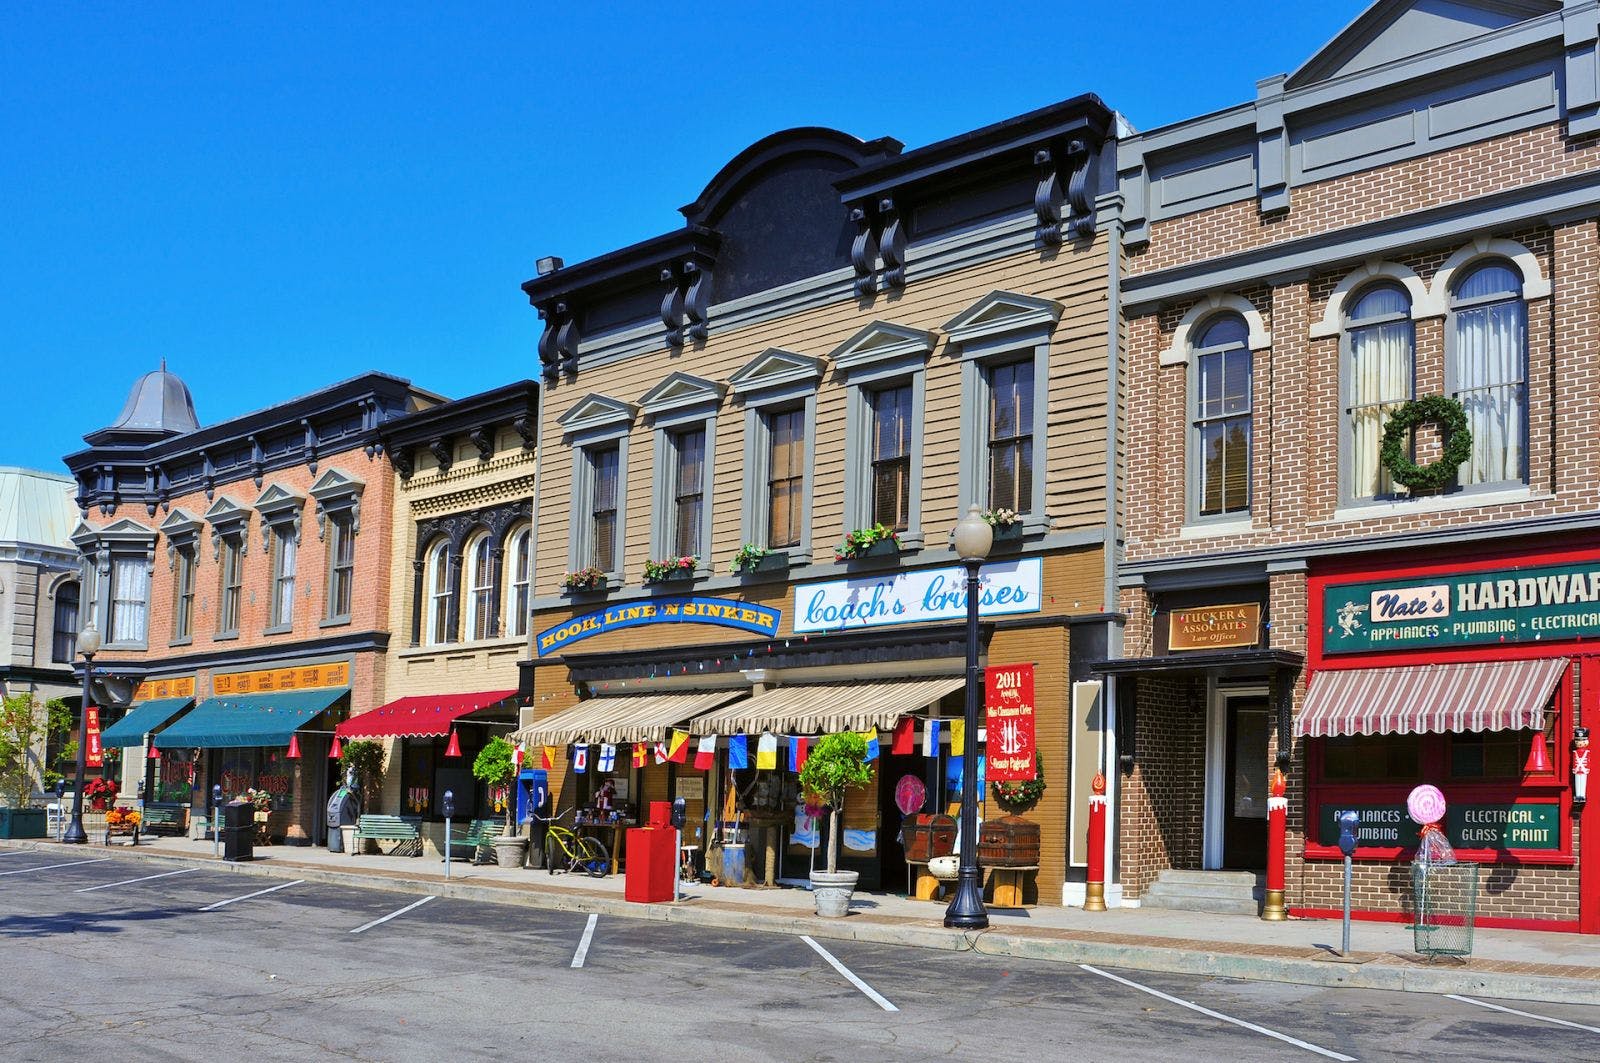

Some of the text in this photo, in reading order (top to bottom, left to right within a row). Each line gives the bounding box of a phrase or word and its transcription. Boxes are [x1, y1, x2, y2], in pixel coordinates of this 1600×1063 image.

[803, 575, 1029, 624] Coach's Cruses
[1376, 590, 1445, 619] Nate's
[1183, 608, 1247, 624] TUCKER &
[541, 617, 602, 650] HOOK,
[605, 605, 657, 625] LINE
[683, 602, 774, 629] SINKER
[1182, 620, 1247, 634] ASSOCIATES
[1370, 612, 1600, 641] APPLIANCES PLUMBING ELECTRICA
[1209, 632, 1237, 643] Offices
[995, 671, 1022, 689] 2011
[1464, 810, 1535, 823] ELECTRICAL
[1462, 828, 1549, 842] GLASS PAINT
